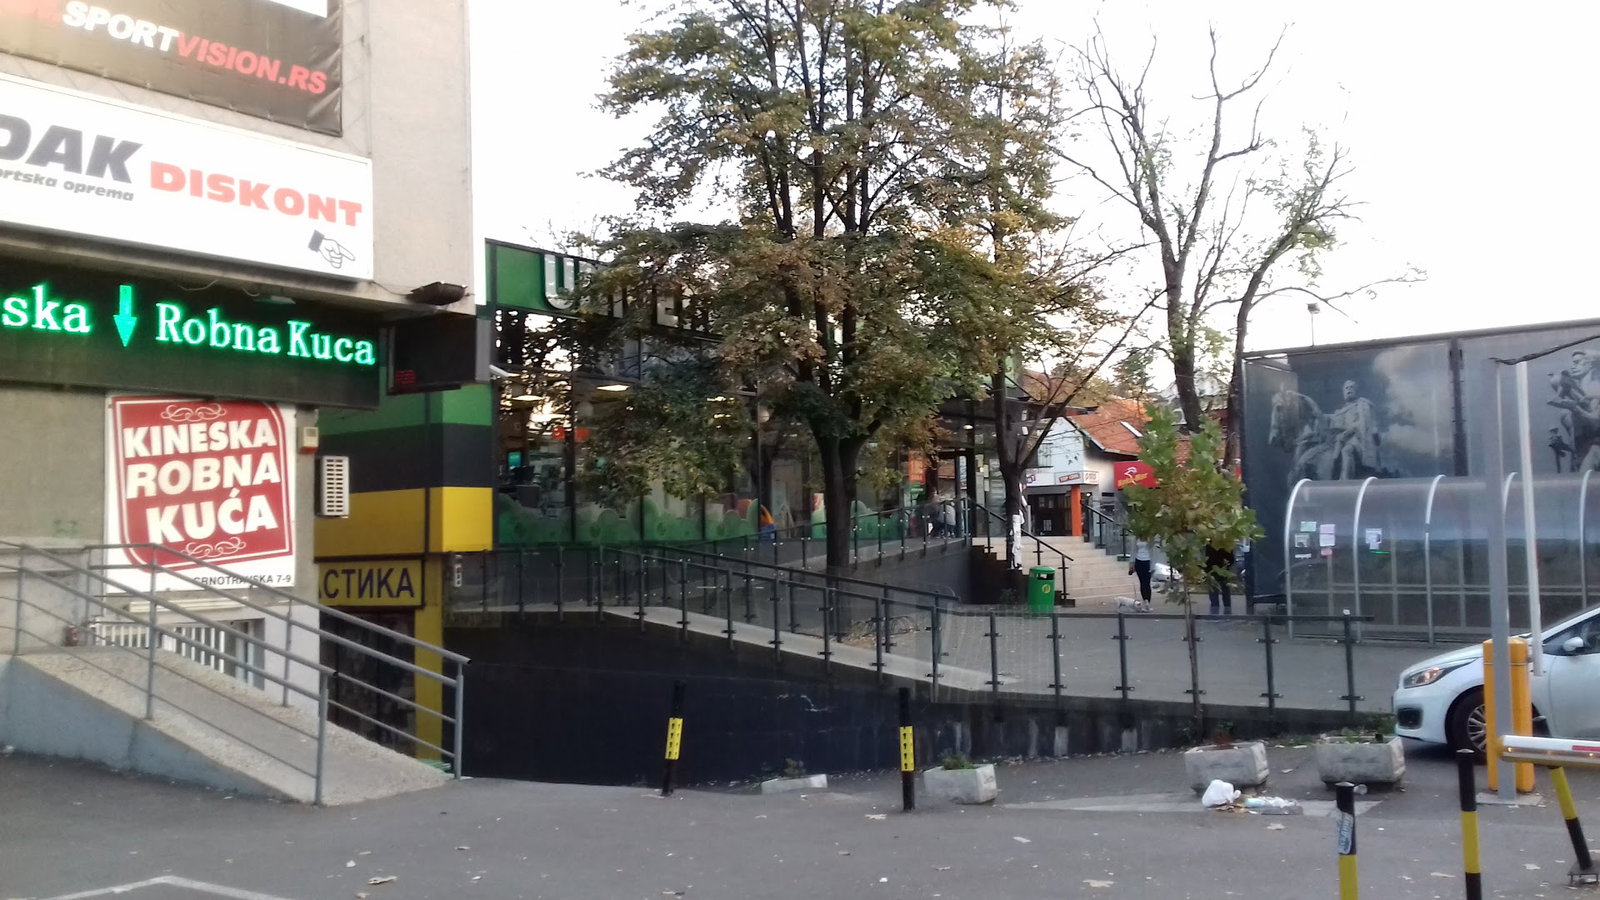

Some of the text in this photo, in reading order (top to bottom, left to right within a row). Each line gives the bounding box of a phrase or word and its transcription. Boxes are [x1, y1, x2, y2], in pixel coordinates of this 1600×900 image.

[63, 180, 134, 201] oprema
[150, 160, 362, 226] DISKONT
[156, 303, 279, 354] Robna
[287, 320, 376, 366] Kuca
[123, 418, 277, 457] KINESKA
[127, 453, 280, 498] ROBNA
[146, 489, 278, 545] KUĆA
[276, 574, 292, 583] 7-9
[319, 567, 414, 598] СТИКА
